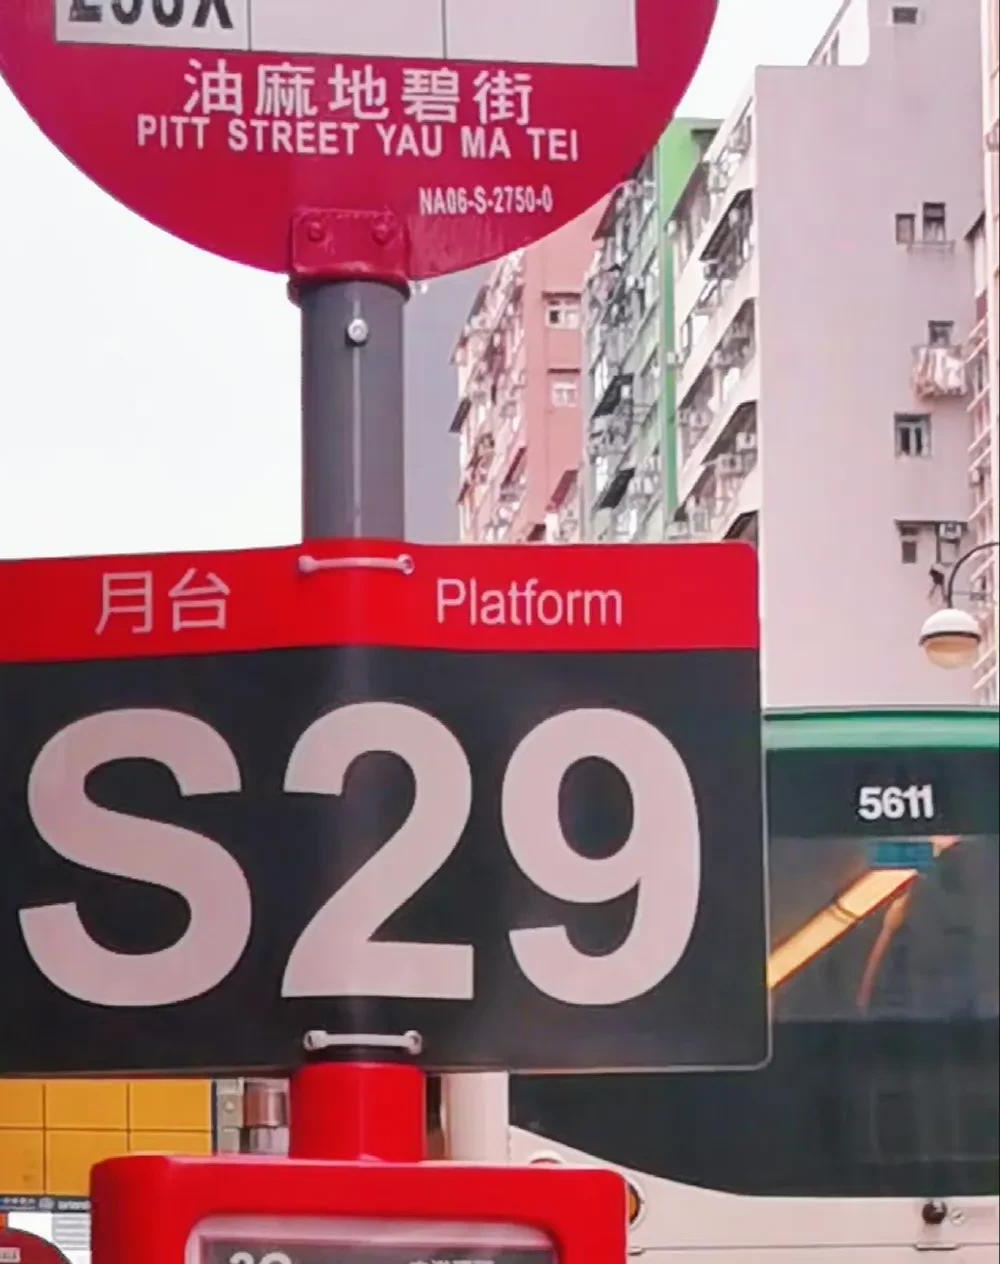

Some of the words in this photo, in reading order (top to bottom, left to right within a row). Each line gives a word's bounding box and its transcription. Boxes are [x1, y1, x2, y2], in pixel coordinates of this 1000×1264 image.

[183, 58, 533, 127] 油麻地碧街
[136, 114, 210, 150] PITT
[227, 119, 360, 156] STREET
[376, 125, 443, 158] YAU
[461, 128, 512, 160] MA
[528, 128, 579, 162] TEI
[94, 568, 231, 635] 月台
[436, 578, 623, 627] Platform
[857, 784, 935, 820] 5611
[18, 700, 702, 1007] S29
